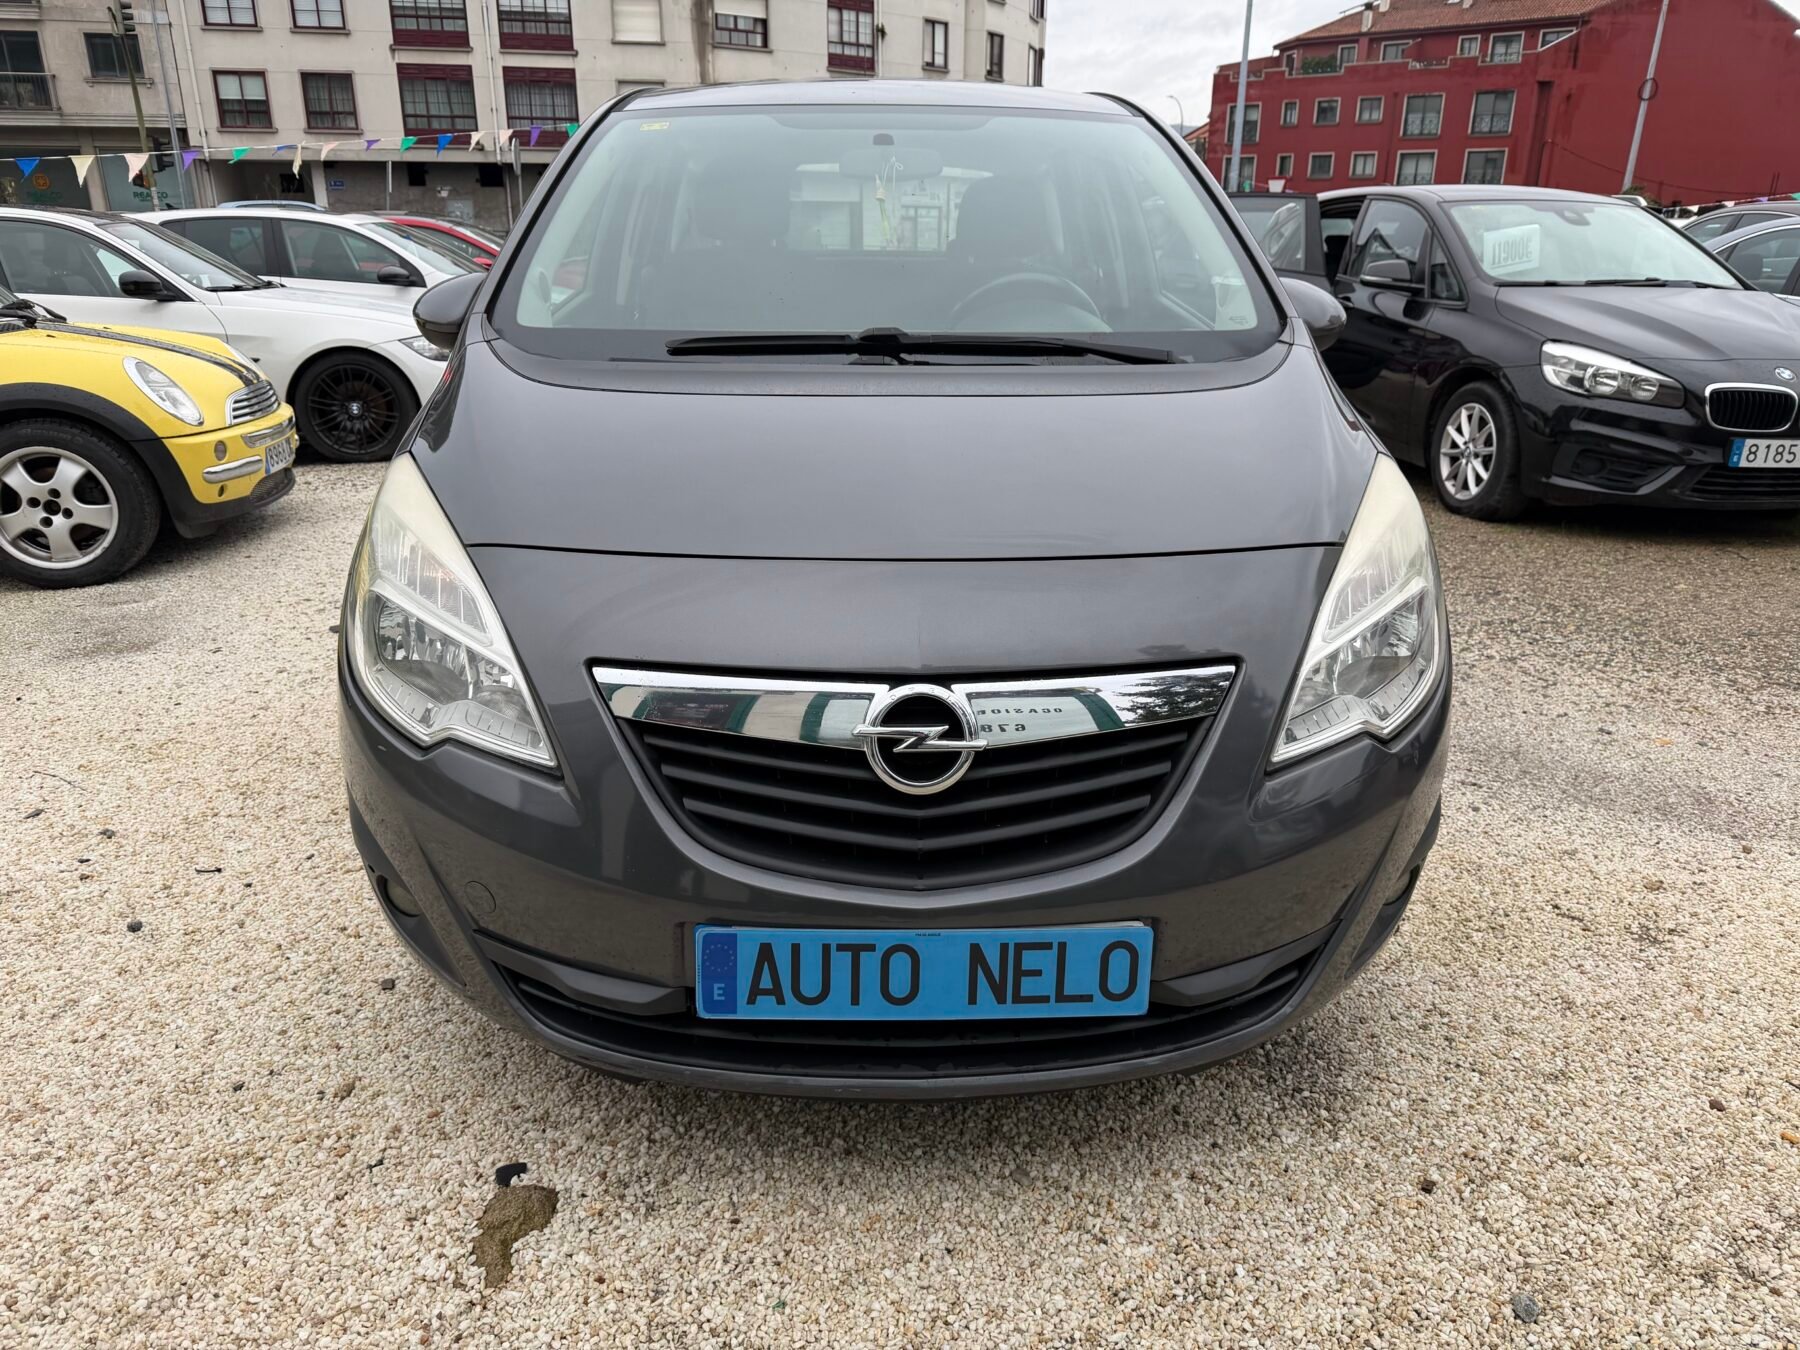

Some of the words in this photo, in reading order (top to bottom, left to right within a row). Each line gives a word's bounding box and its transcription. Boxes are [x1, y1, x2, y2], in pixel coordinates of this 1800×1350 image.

[133, 191, 168, 199] REACO
[1746, 444, 1798, 463] 8185
[746, 942, 920, 1006] AUTO
[967, 940, 1139, 1005] NELO
[713, 983, 726, 1000] E
